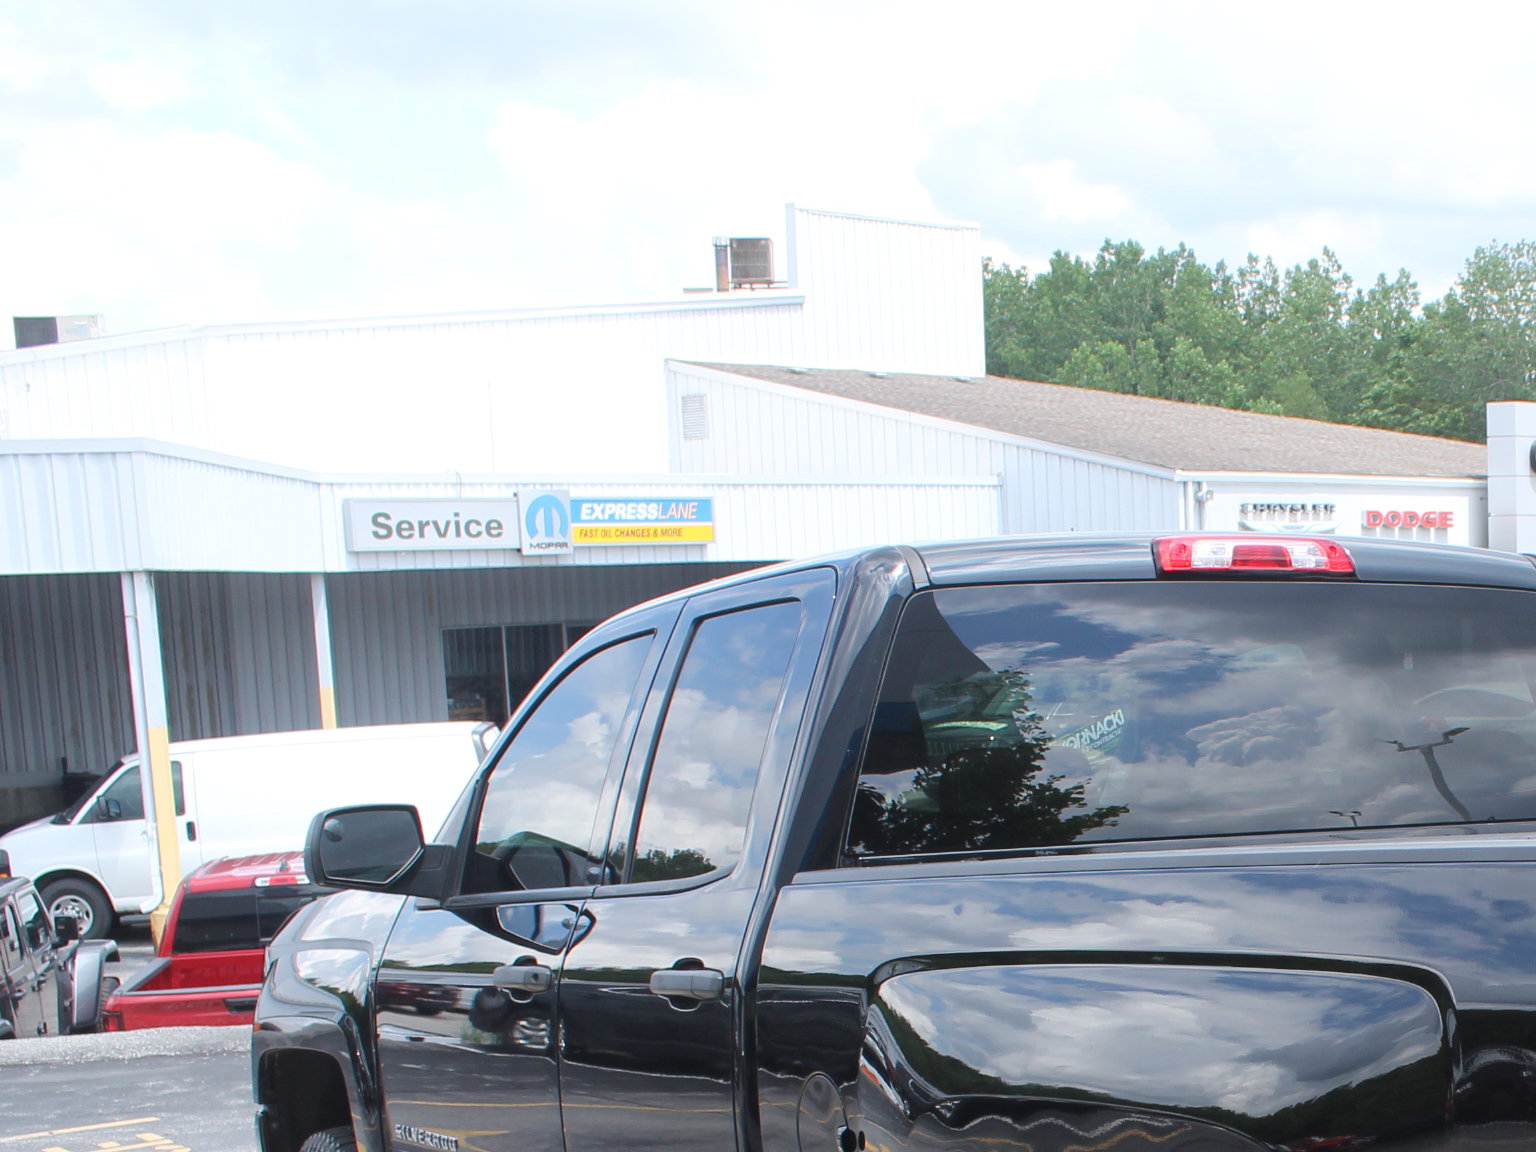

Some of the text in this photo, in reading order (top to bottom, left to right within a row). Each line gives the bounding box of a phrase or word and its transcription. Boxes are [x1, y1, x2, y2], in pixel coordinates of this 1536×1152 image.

[1239, 502, 1336, 515] CHRYSLER
[371, 511, 504, 541] Service
[1363, 510, 1454, 528] DODGE
[579, 529, 598, 538] FAST
[600, 529, 612, 538] OIL
[614, 528, 651, 538] CHANGES
[660, 527, 683, 537] MORE
[529, 541, 569, 550] MOPAR
[395, 1123, 459, 1152] SILVERADO
